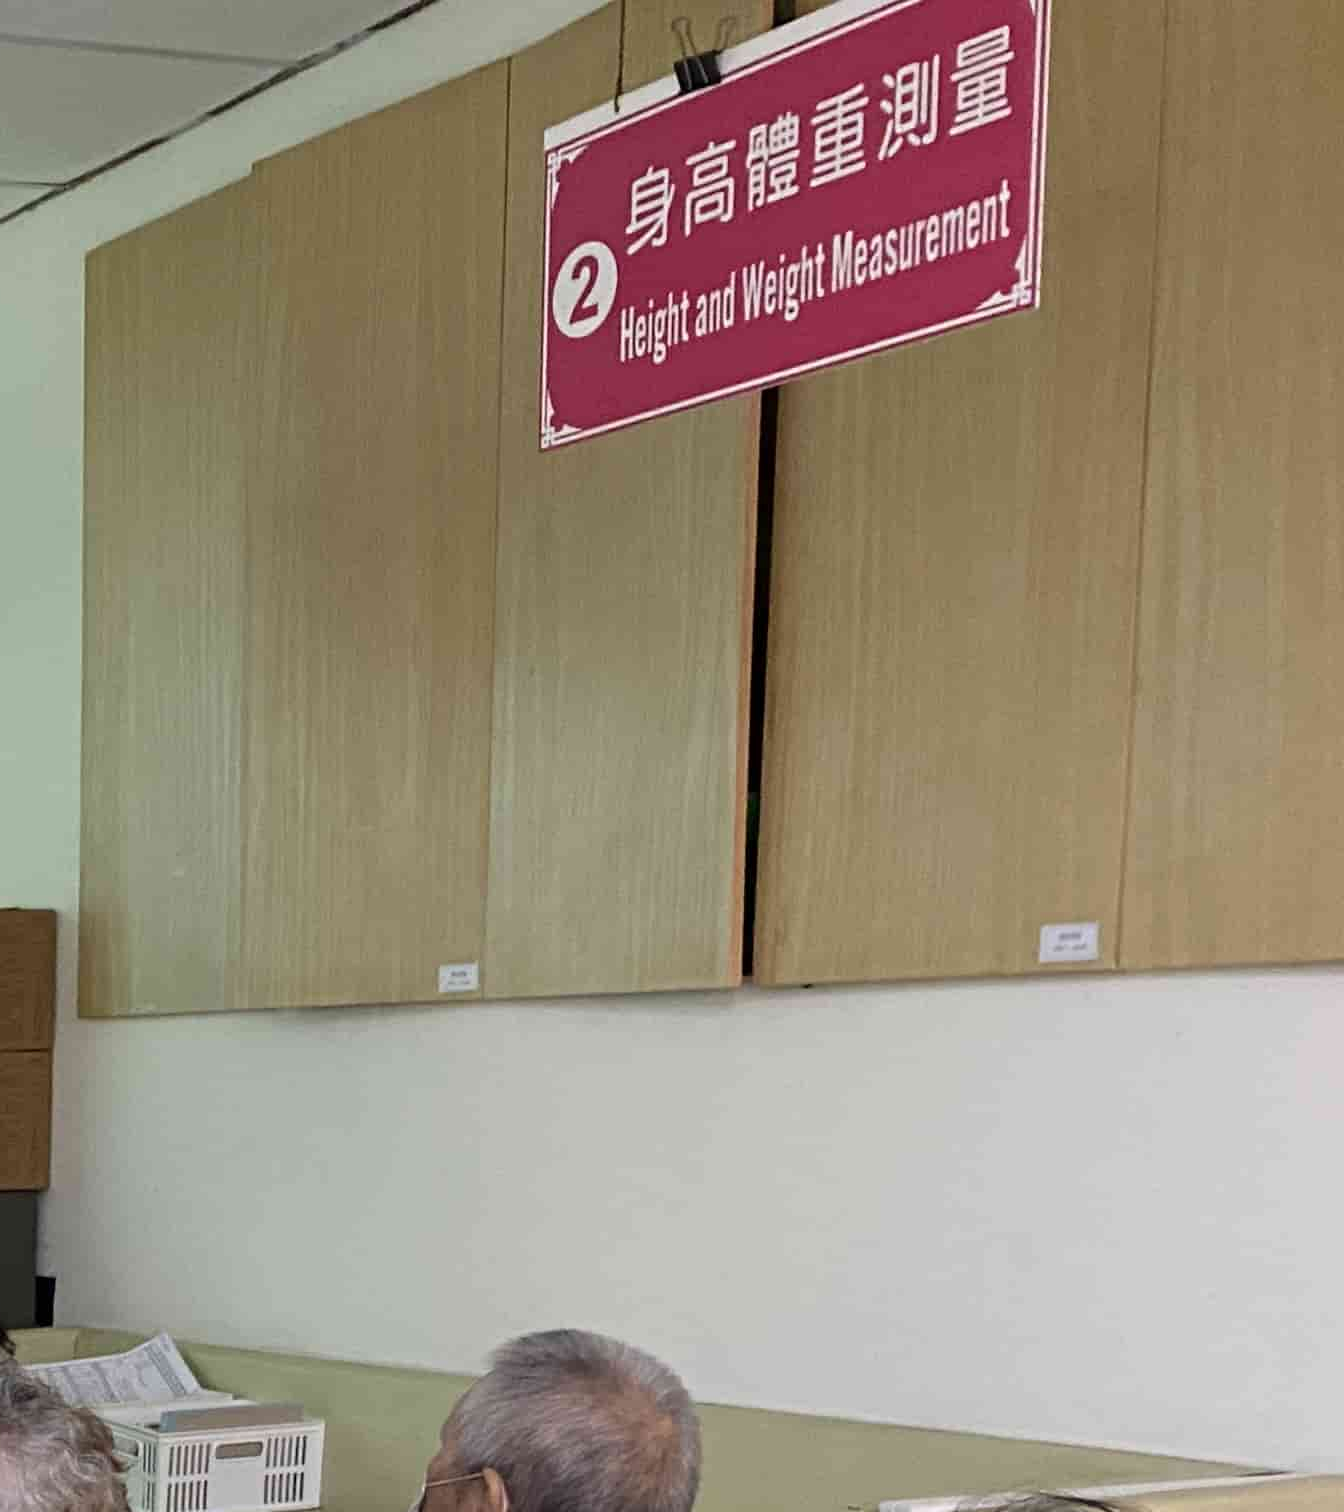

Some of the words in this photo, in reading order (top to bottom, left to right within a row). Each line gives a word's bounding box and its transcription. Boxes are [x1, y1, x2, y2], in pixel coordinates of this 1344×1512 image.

[625, 25, 1015, 256] 身高體重測量
[570, 253, 602, 326] 2
[619, 279, 690, 364] Height
[696, 271, 736, 340] and
[741, 243, 826, 322] Weight
[831, 178, 1011, 293] Measurement
